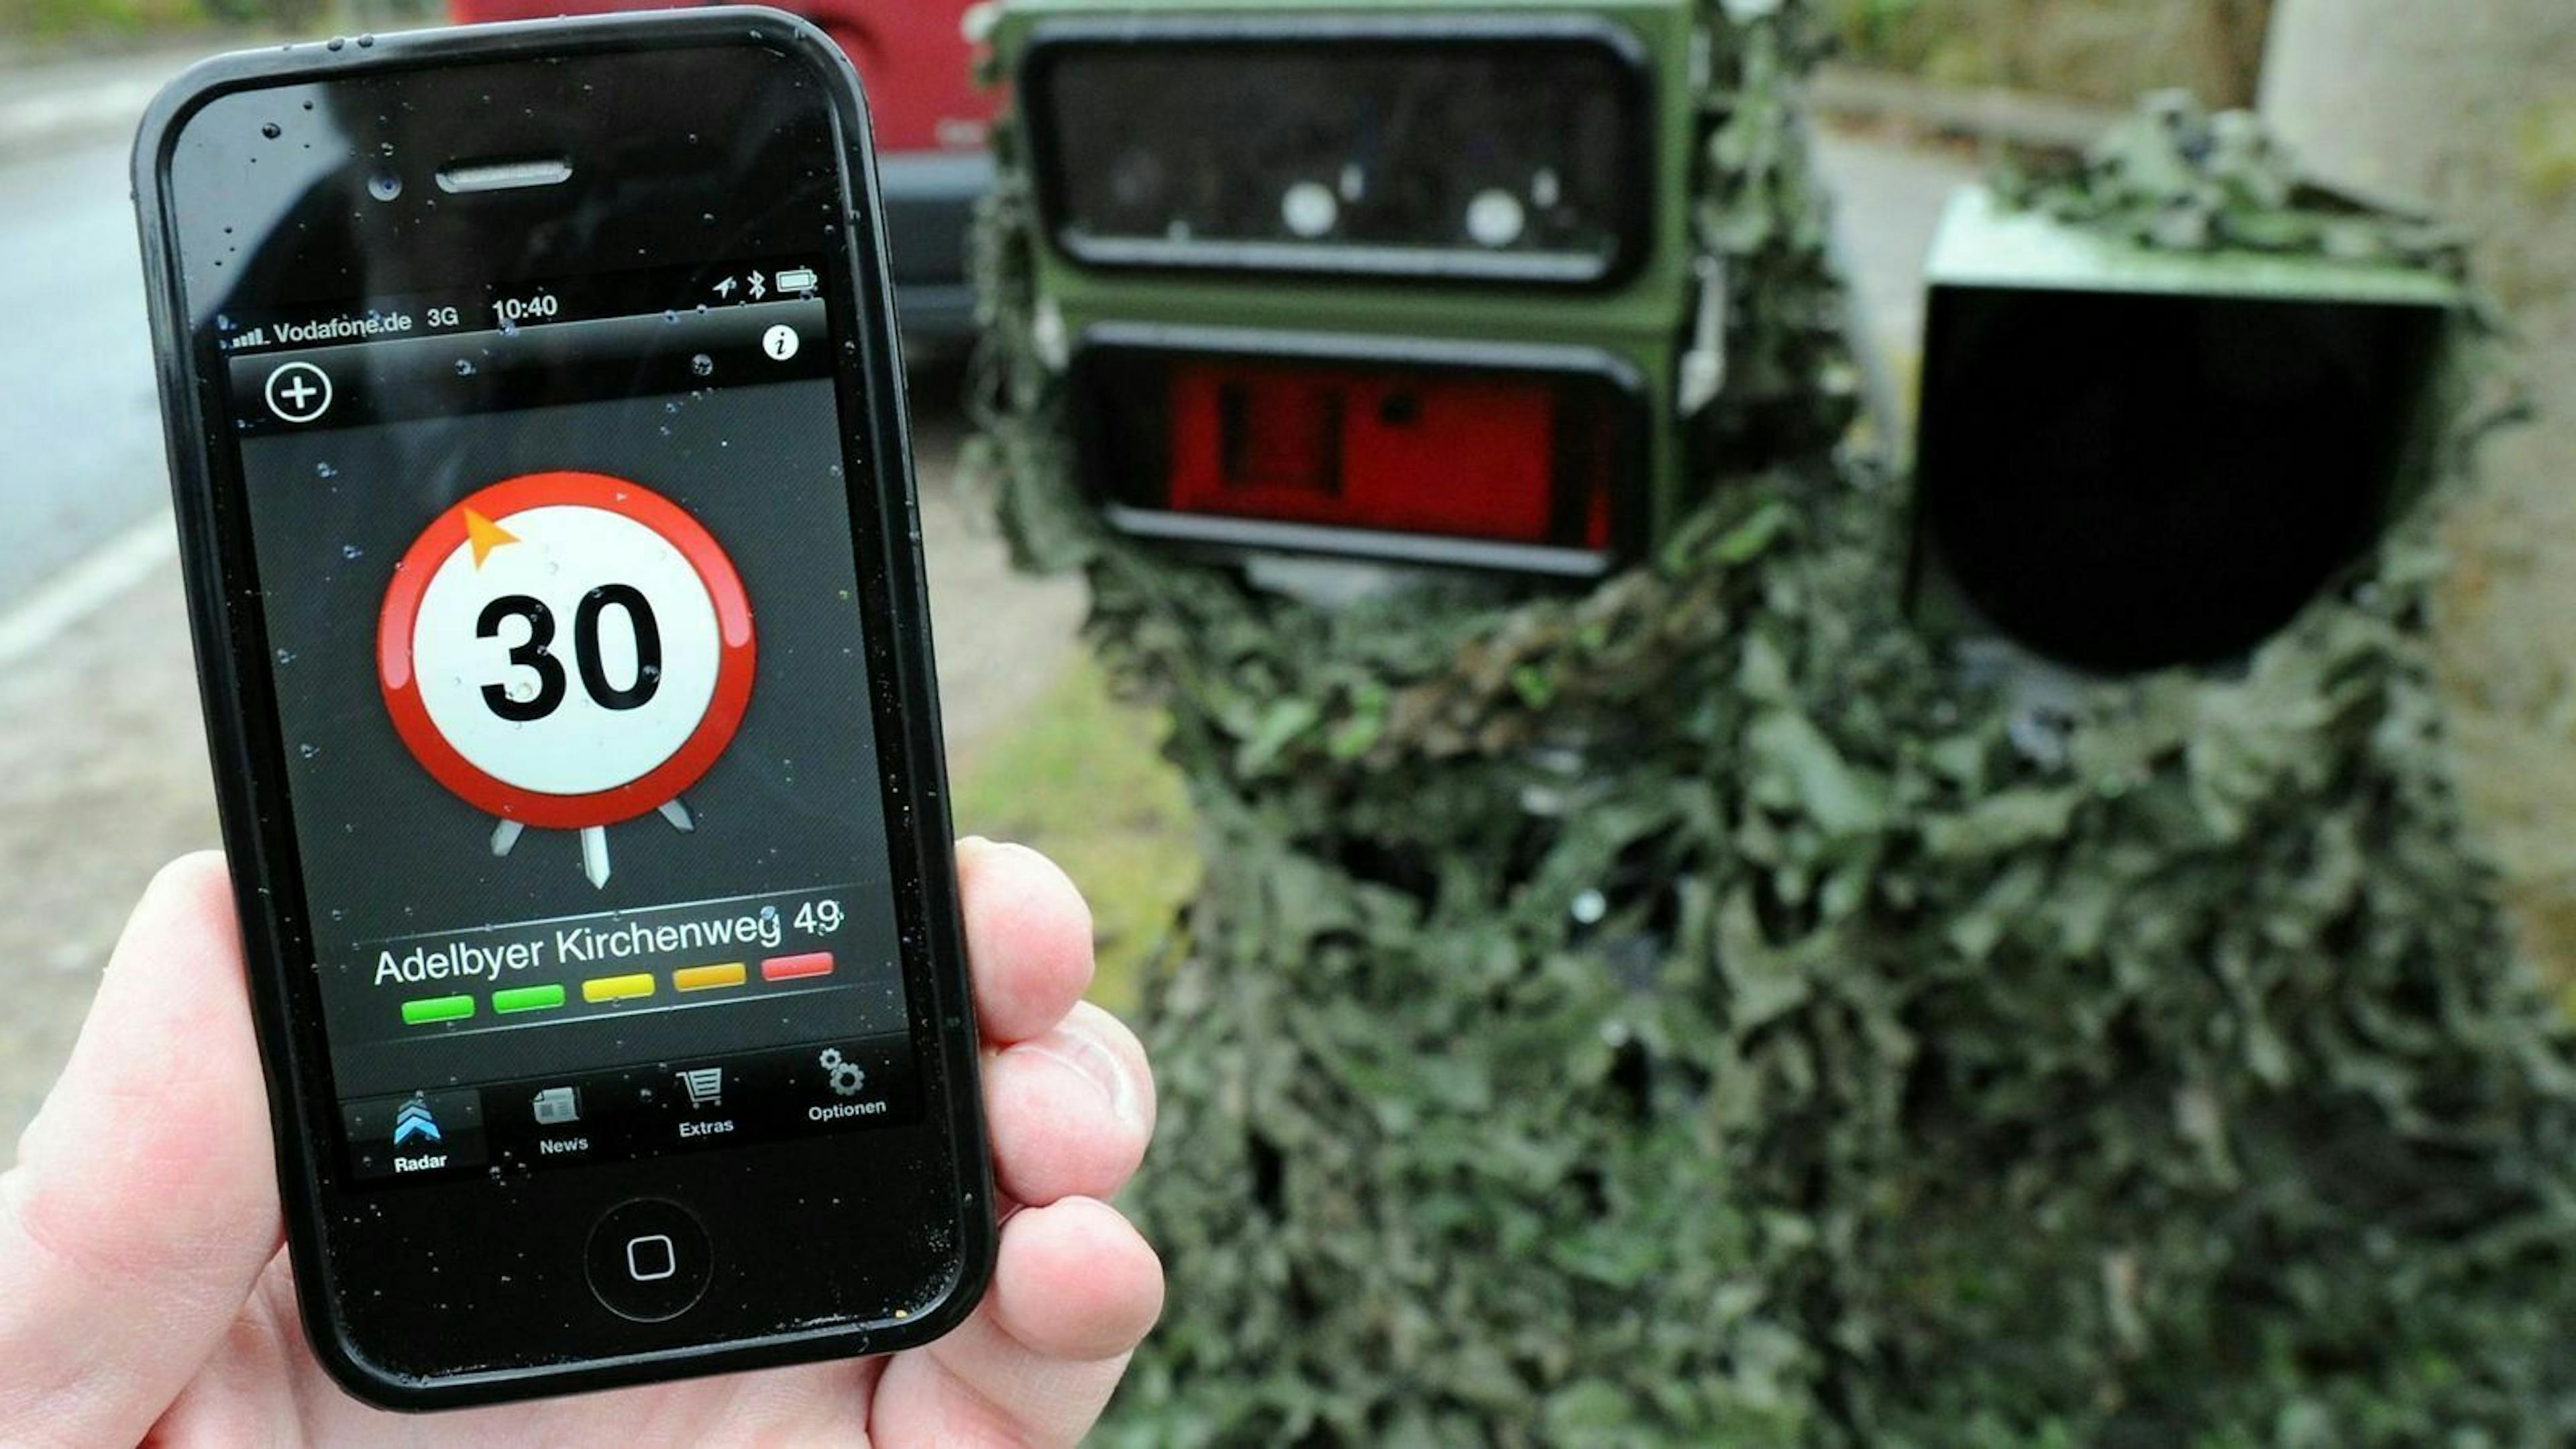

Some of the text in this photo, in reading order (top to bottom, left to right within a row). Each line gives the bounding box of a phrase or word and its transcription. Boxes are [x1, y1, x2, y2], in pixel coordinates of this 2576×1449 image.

[492, 295, 558, 321] 10:40
[274, 307, 460, 344] Vodafone.de 3G
[476, 584, 662, 722] 30
[373, 899, 841, 986] Adelbyer Kirchenweg 49
[808, 1098, 887, 1122] Optionen
[679, 1118, 734, 1138] Extras
[539, 1136, 589, 1155] News
[394, 1152, 447, 1174] Radar
